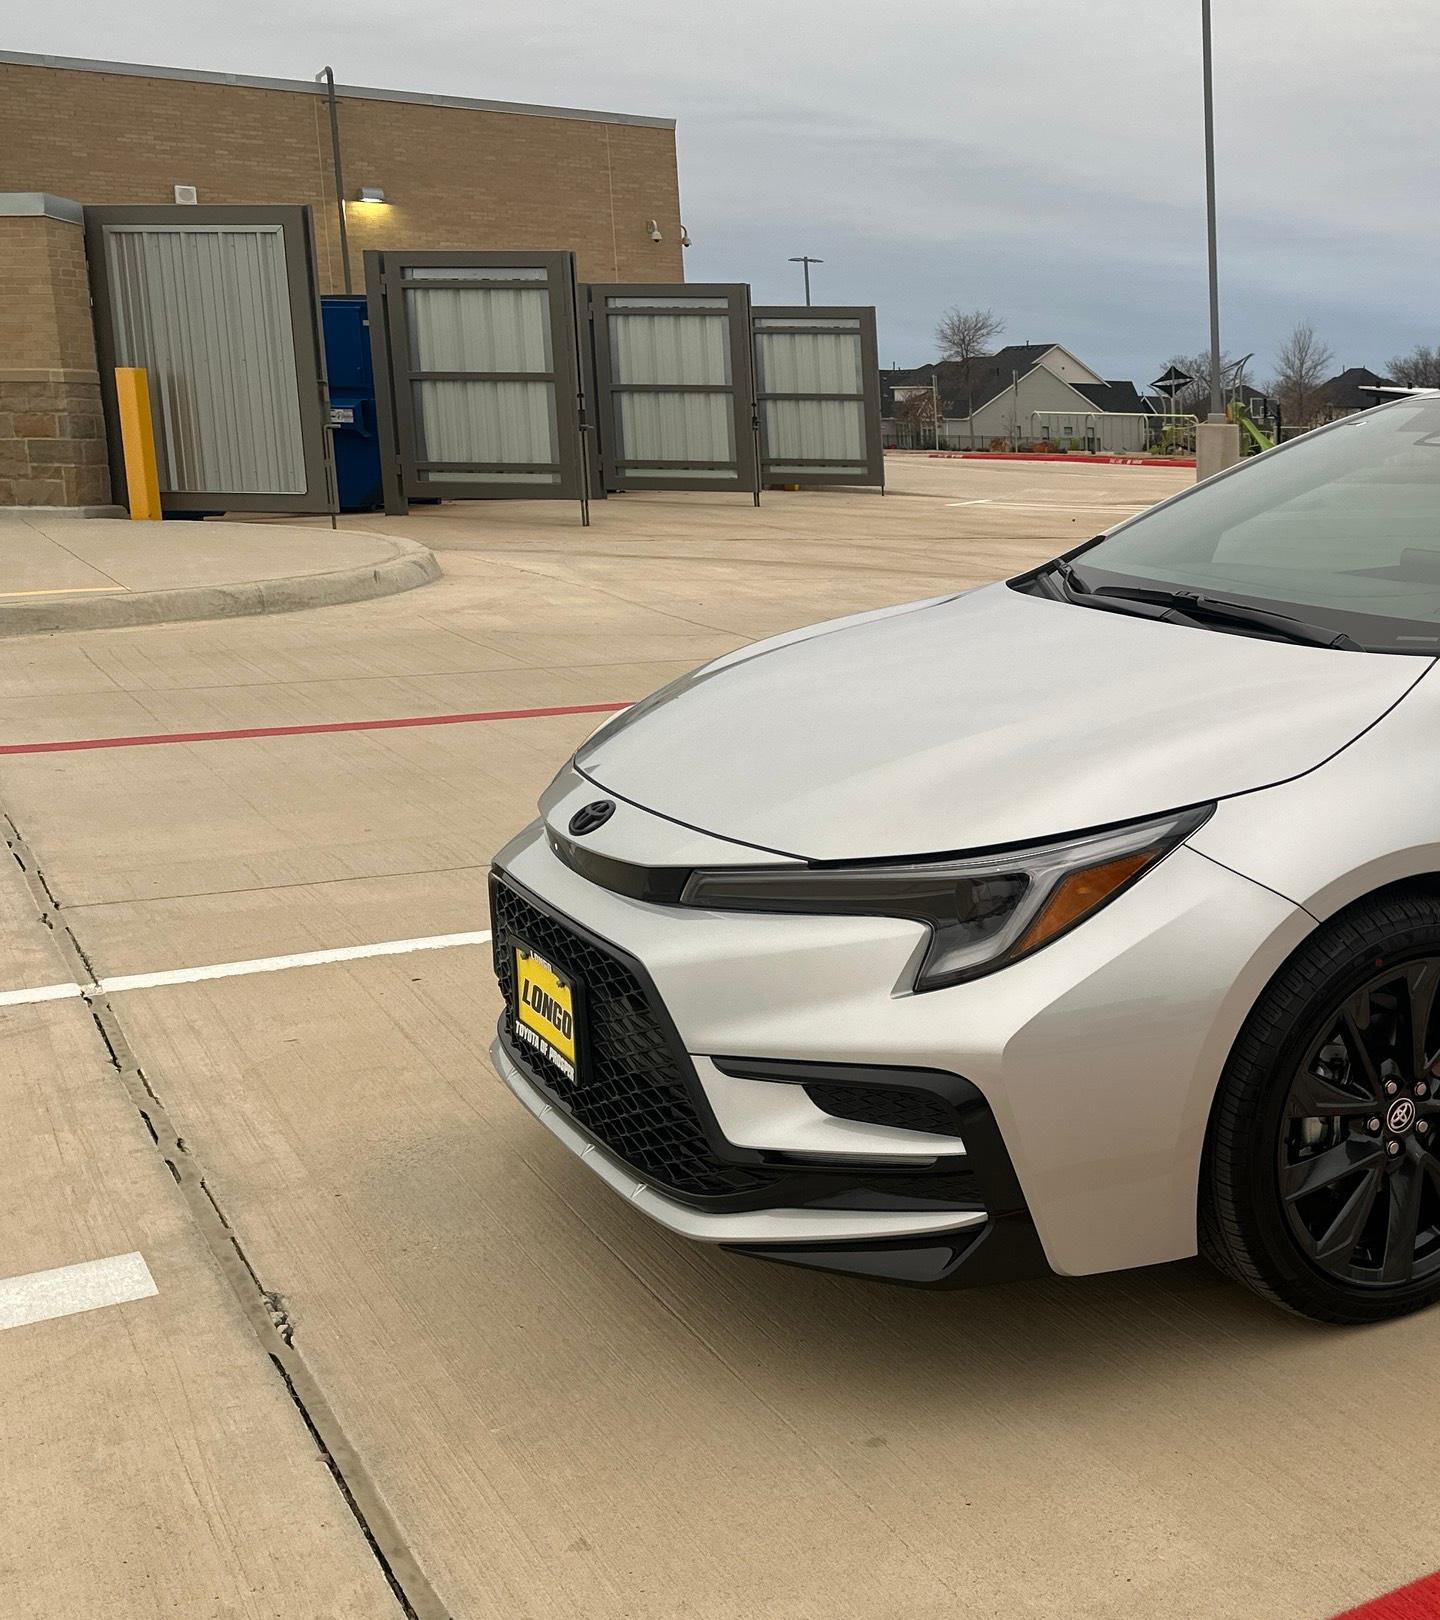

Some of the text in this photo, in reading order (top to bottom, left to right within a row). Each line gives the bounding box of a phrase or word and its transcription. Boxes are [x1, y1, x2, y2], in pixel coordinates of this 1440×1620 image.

[522, 978, 572, 1040] LONGO
[515, 1020, 539, 1050] TOYOTA
[540, 1039, 549, 1056] OF
